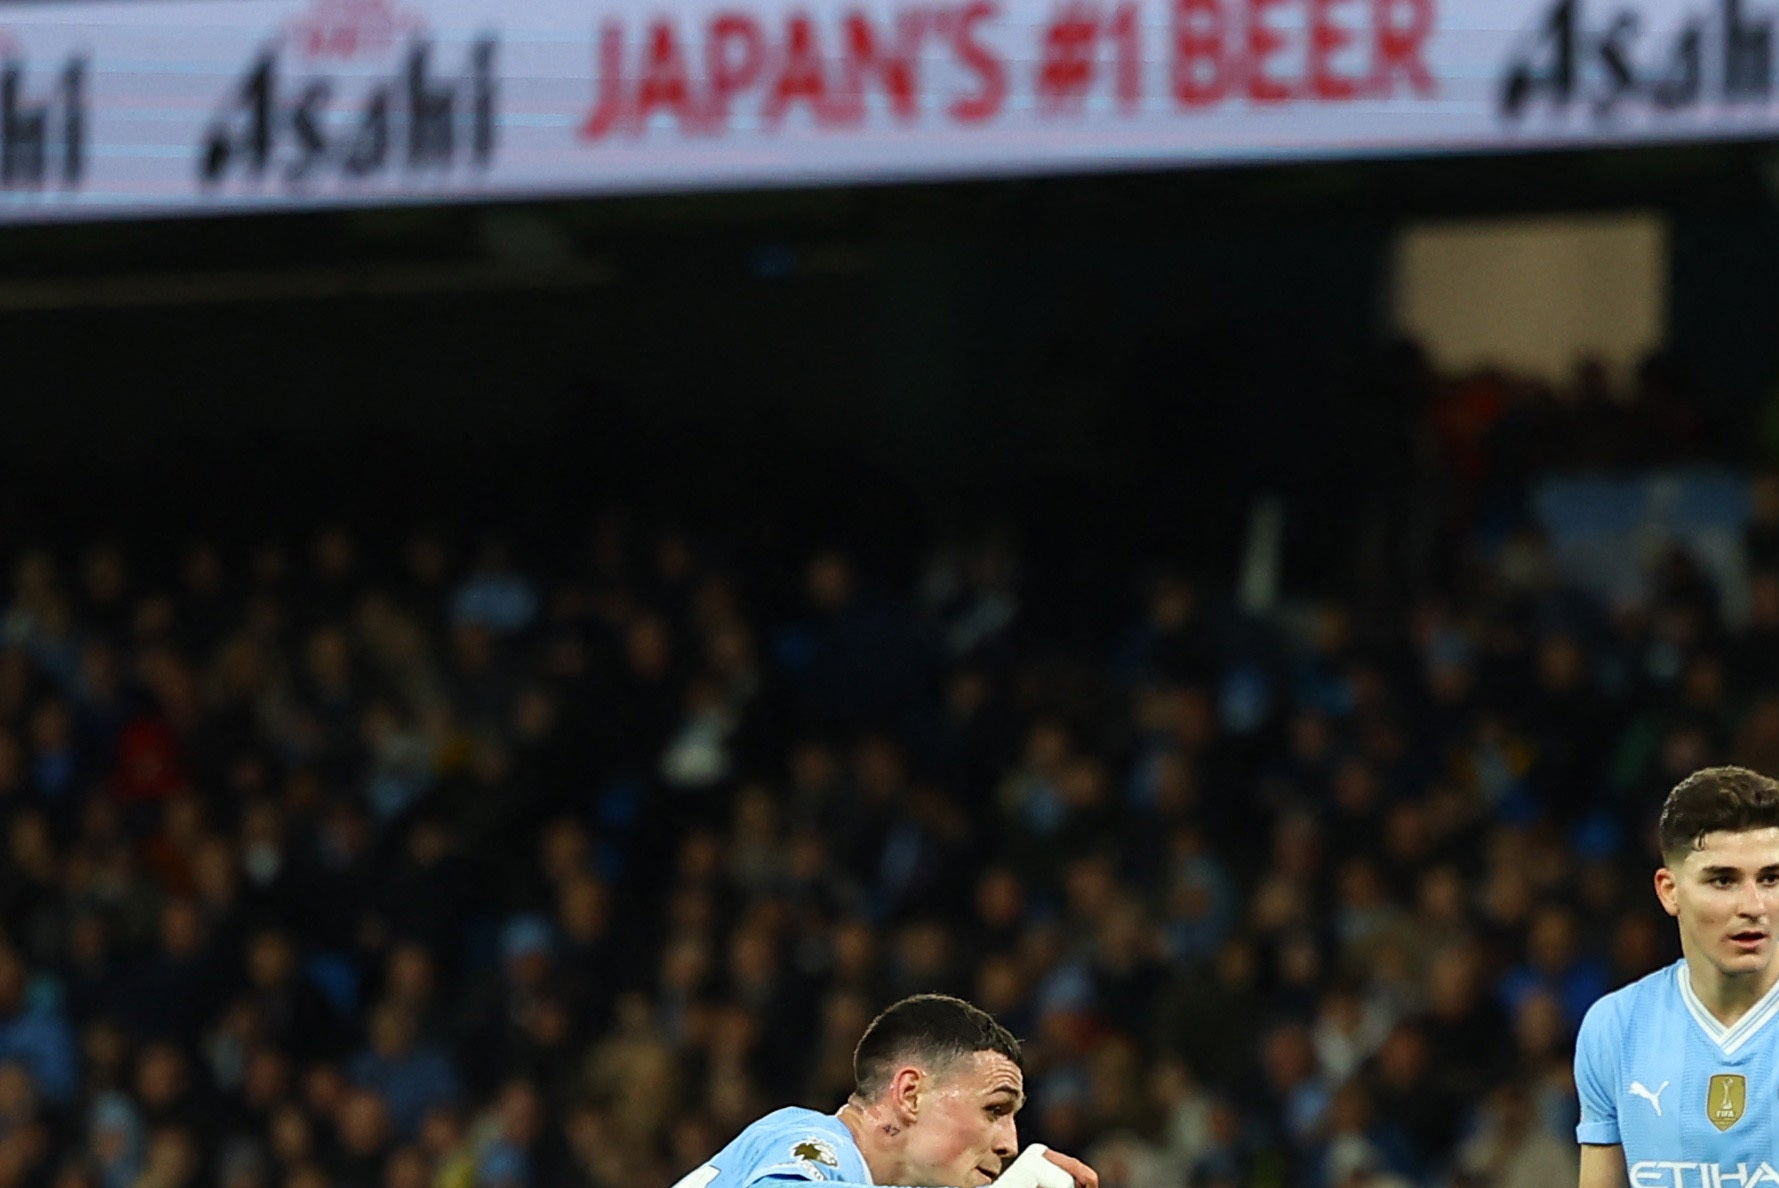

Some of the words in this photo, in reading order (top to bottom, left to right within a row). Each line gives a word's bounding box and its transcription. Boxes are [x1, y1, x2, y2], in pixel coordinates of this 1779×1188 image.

[197, 30, 502, 185] Asahi
[577, 4, 1006, 142] JAPAN'S
[1038, 6, 1144, 120] #1
[1168, 0, 1438, 112] BEER
[1716, 1110, 1735, 1118] FIFA
